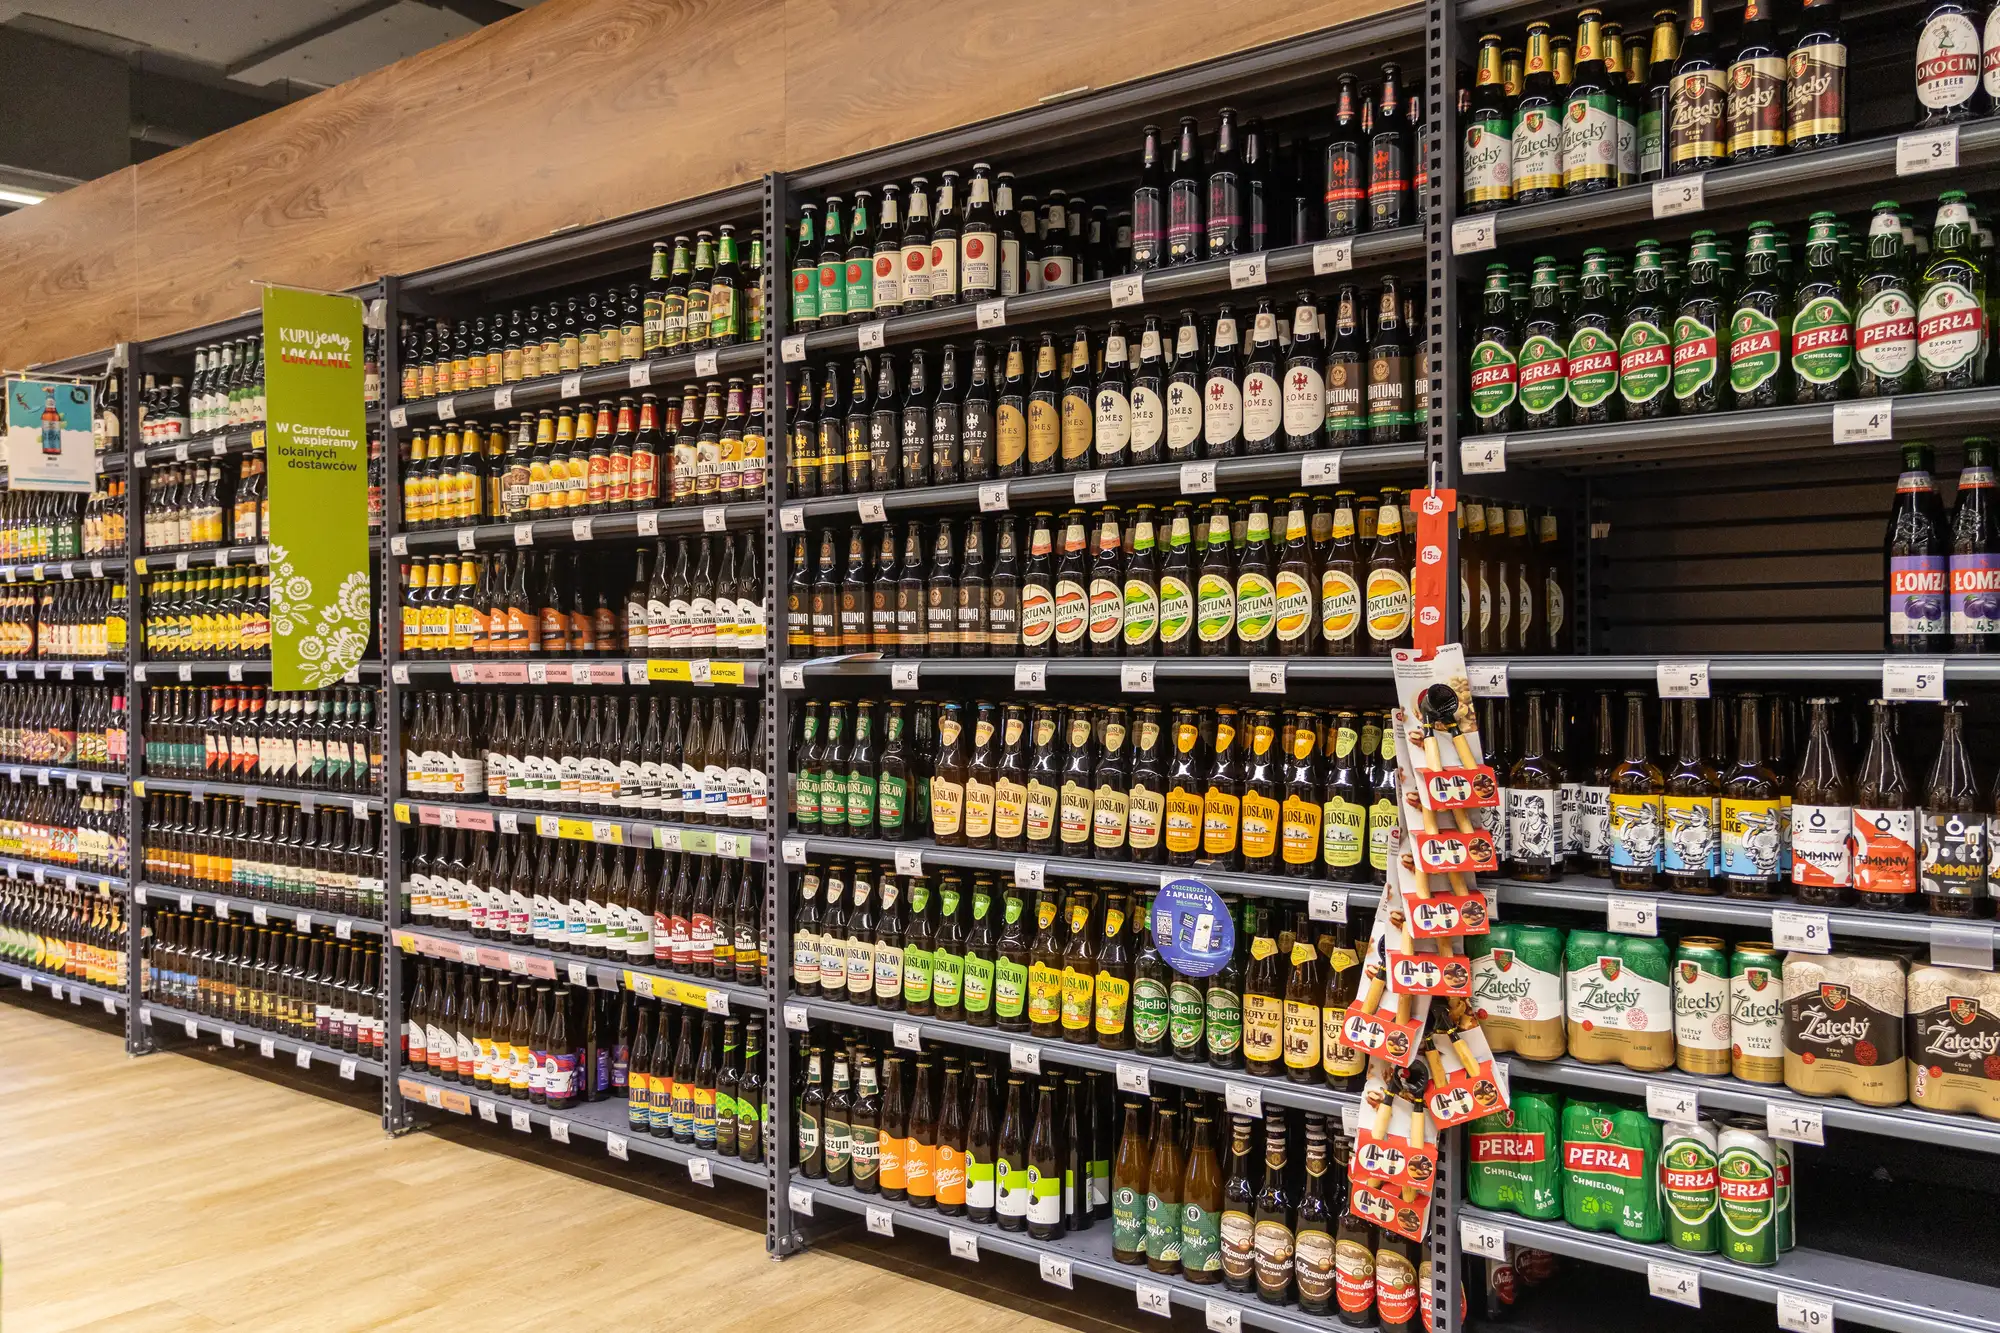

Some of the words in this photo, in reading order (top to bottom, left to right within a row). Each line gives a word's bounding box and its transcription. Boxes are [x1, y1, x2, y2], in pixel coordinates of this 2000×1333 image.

[1917, 56, 1976, 80] OKOCIM
[1944, 77, 1964, 86] BEER
[1932, 143, 1942, 158] 3
[1683, 189, 1692, 202] 3
[1477, 229, 1485, 241] 3
[1920, 313, 1974, 338] PERŁA
[1798, 330, 1848, 350] PERŁA
[1863, 323, 1915, 344] PERŁA
[1875, 346, 1907, 354] EXPORT
[1929, 339, 1962, 348] EXPORT
[281, 347, 353, 370] LOKALNIE
[1621, 349, 1665, 371] PERŁA
[1803, 352, 1843, 361] CHMIELOWA
[1520, 362, 1561, 383] PERŁA
[1569, 355, 1613, 376] PERŁA
[1472, 367, 1510, 385] PERŁA
[1573, 378, 1606, 386] CHMIELOWA
[1624, 372, 1658, 381] CHMIELOWA
[1474, 389, 1504, 398] CHMIELOWA
[1524, 385, 1555, 393] CHMIELOWA
[1286, 393, 1319, 403] KOMES
[1869, 414, 1880, 429] 4
[276, 422, 290, 433] W
[292, 423, 350, 438] Carrefour
[292, 435, 358, 451] wspieramy
[277, 446, 338, 460] lokalnych
[1484, 450, 1493, 463] 4
[287, 458, 358, 473] dostawców
[1368, 593, 1408, 612] FORTUNA
[1490, 674, 1498, 686] 4
[1690, 673, 1699, 686] 5
[1916, 674, 1927, 689] 5
[1725, 807, 1735, 819] BE
[1723, 820, 1741, 833] LIKE
[1173, 891, 1213, 902] APLIKACJĄ
[1637, 911, 1646, 924] 9
[1806, 925, 1815, 939] 8
[1474, 968, 1531, 999] Žatecký
[1579, 977, 1640, 1011] Žatecký
[1799, 1004, 1870, 1047] Žatecký
[1747, 1036, 1772, 1044] SVĚTLÝ
[1676, 1100, 1685, 1113] 4
[1792, 1118, 1811, 1133] 17
[1479, 1139, 1535, 1156] PERŁA
[1569, 1147, 1630, 1170] PERŁA
[1483, 1167, 1534, 1182] CHMIELOWA
[1667, 1171, 1715, 1187] PERŁA
[1572, 1174, 1625, 1196] CHMIELOWA
[1721, 1181, 1769, 1197] PERŁA
[1672, 1192, 1710, 1202] CHMIELOWA
[1724, 1201, 1763, 1214] CHMIELOWA
[1478, 1234, 1494, 1249] 18
[1677, 1280, 1686, 1294] 4
[1800, 1309, 1820, 1325] 19
